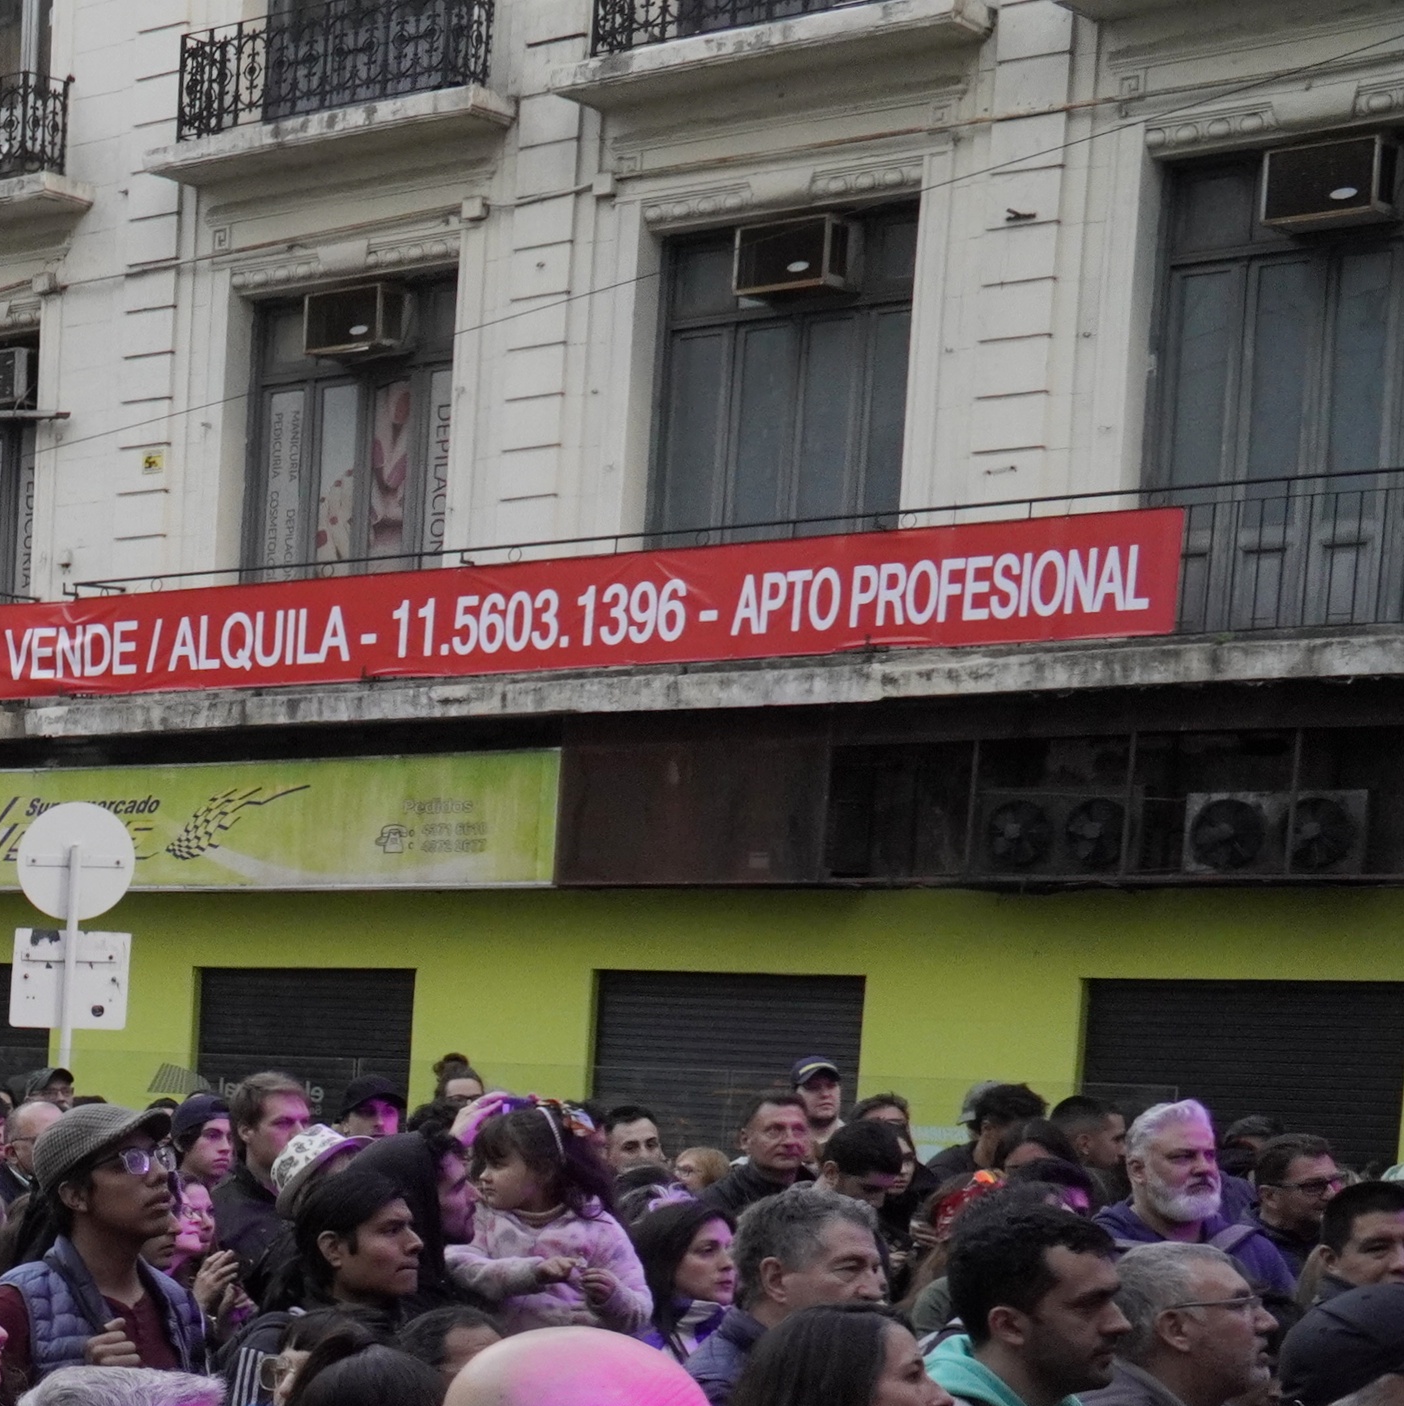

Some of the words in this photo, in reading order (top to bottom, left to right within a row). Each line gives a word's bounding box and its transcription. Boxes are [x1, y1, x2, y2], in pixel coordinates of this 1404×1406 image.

[5, 620, 139, 681] VENDE
[146, 618, 164, 673] /
[168, 605, 351, 672] ALQUILA
[360, 632, 377, 646] -
[392, 578, 688, 658] 11.5603.1396
[698, 609, 719, 623] -
[731, 566, 842, 636] APTO
[849, 544, 1150, 629] PROFESIONAL
[403, 797, 473, 815] Pedidos
